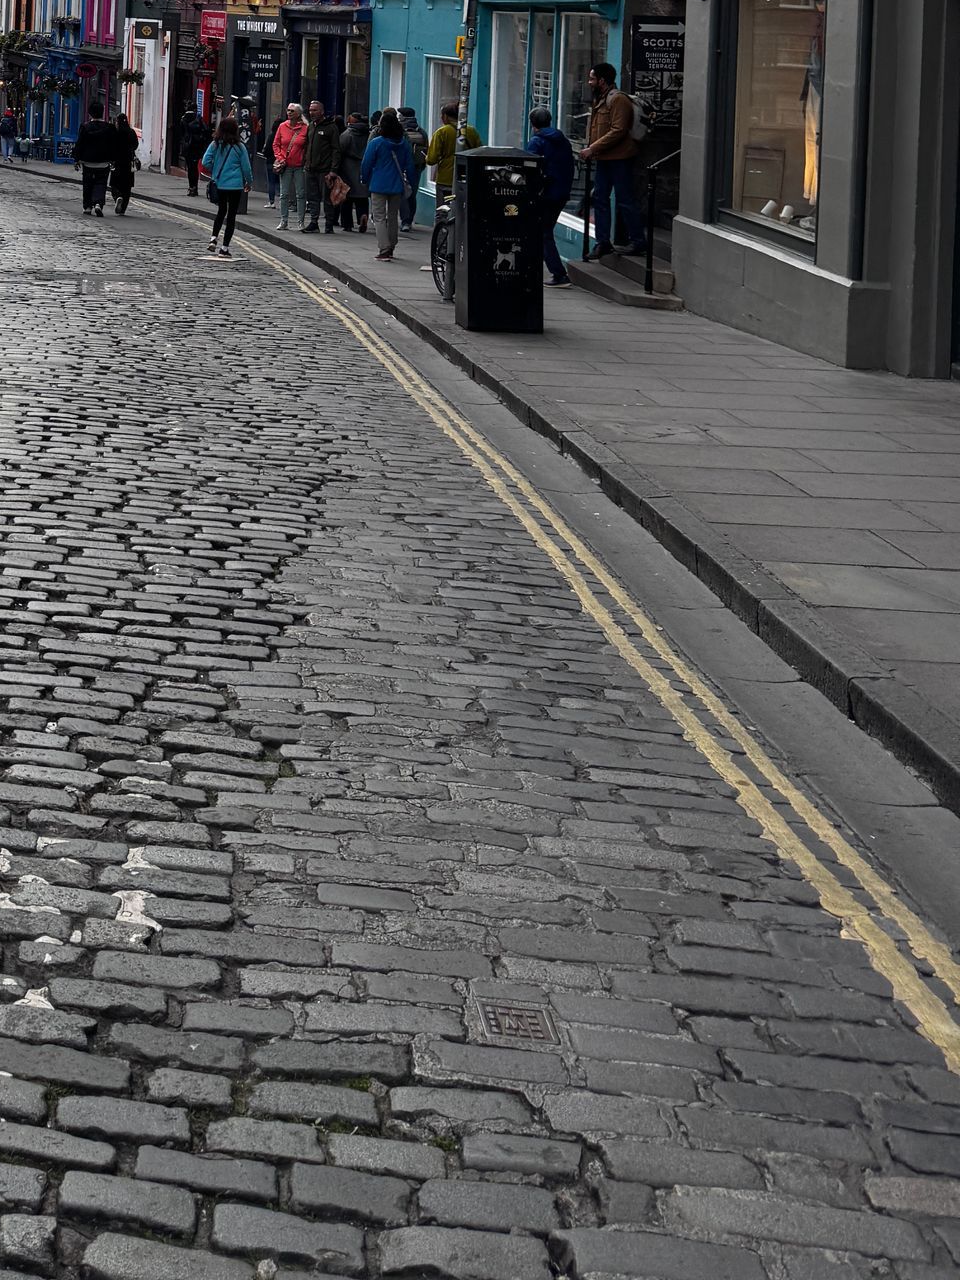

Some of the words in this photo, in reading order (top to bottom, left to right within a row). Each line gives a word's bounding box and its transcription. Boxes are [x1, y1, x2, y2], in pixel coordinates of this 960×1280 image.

[237, 20, 246, 31] THE
[246, 20, 264, 32] WHISKY
[264, 22, 277, 33] SHOP
[642, 38, 684, 47] SCOTTS
[494, 187, 520, 196] Litter
